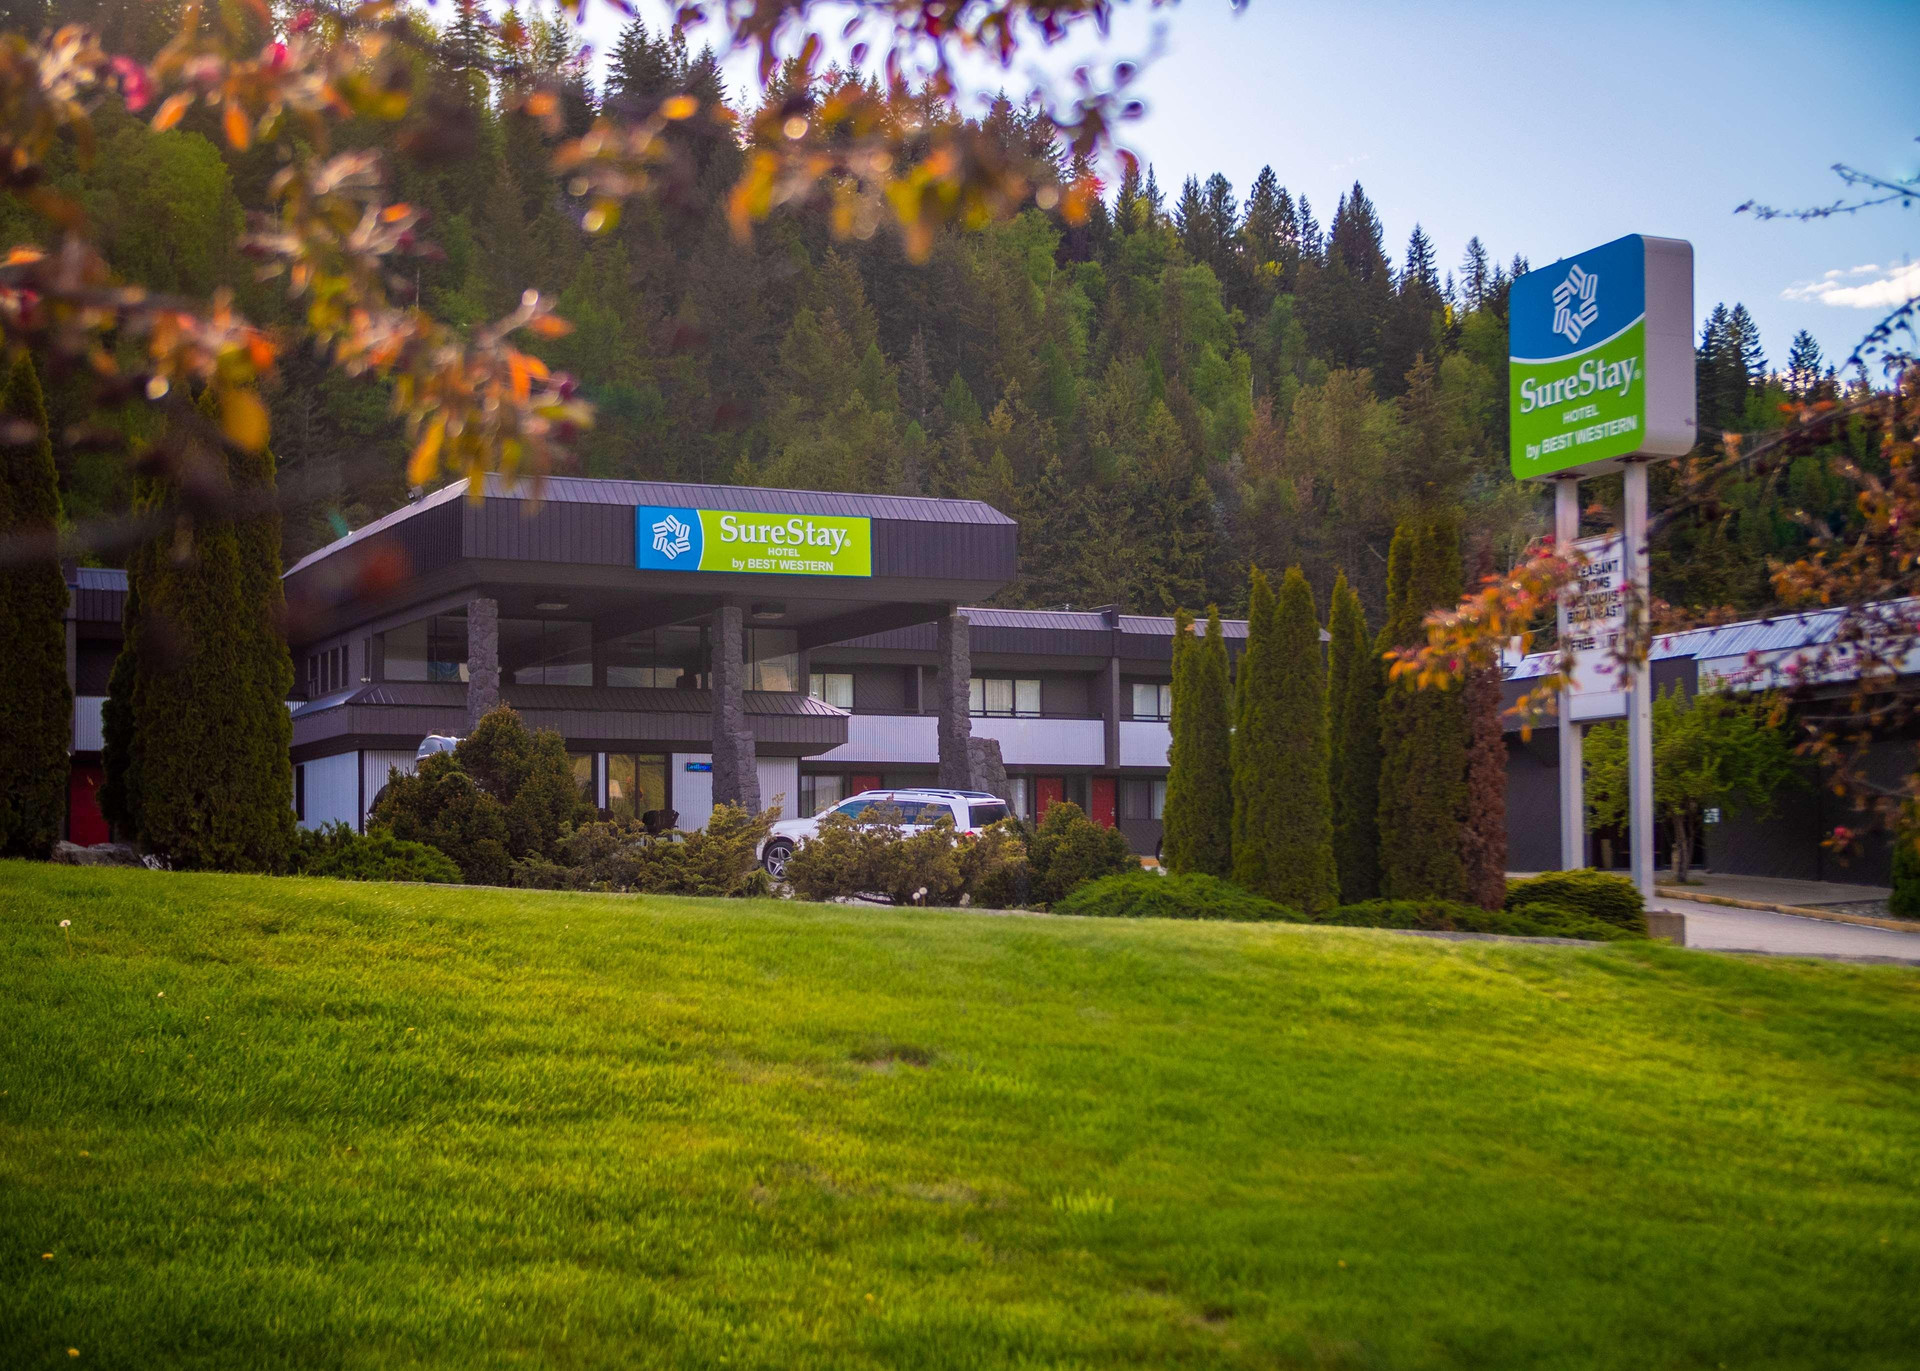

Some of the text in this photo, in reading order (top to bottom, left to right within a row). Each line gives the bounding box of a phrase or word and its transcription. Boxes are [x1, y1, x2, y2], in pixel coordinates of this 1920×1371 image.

[1562, 404, 1600, 424] HOTEL
[1525, 415, 1637, 460] by BEST WESTERN
[767, 547, 800, 557] HOTEL
[732, 557, 834, 572] by BEST WESTERN
